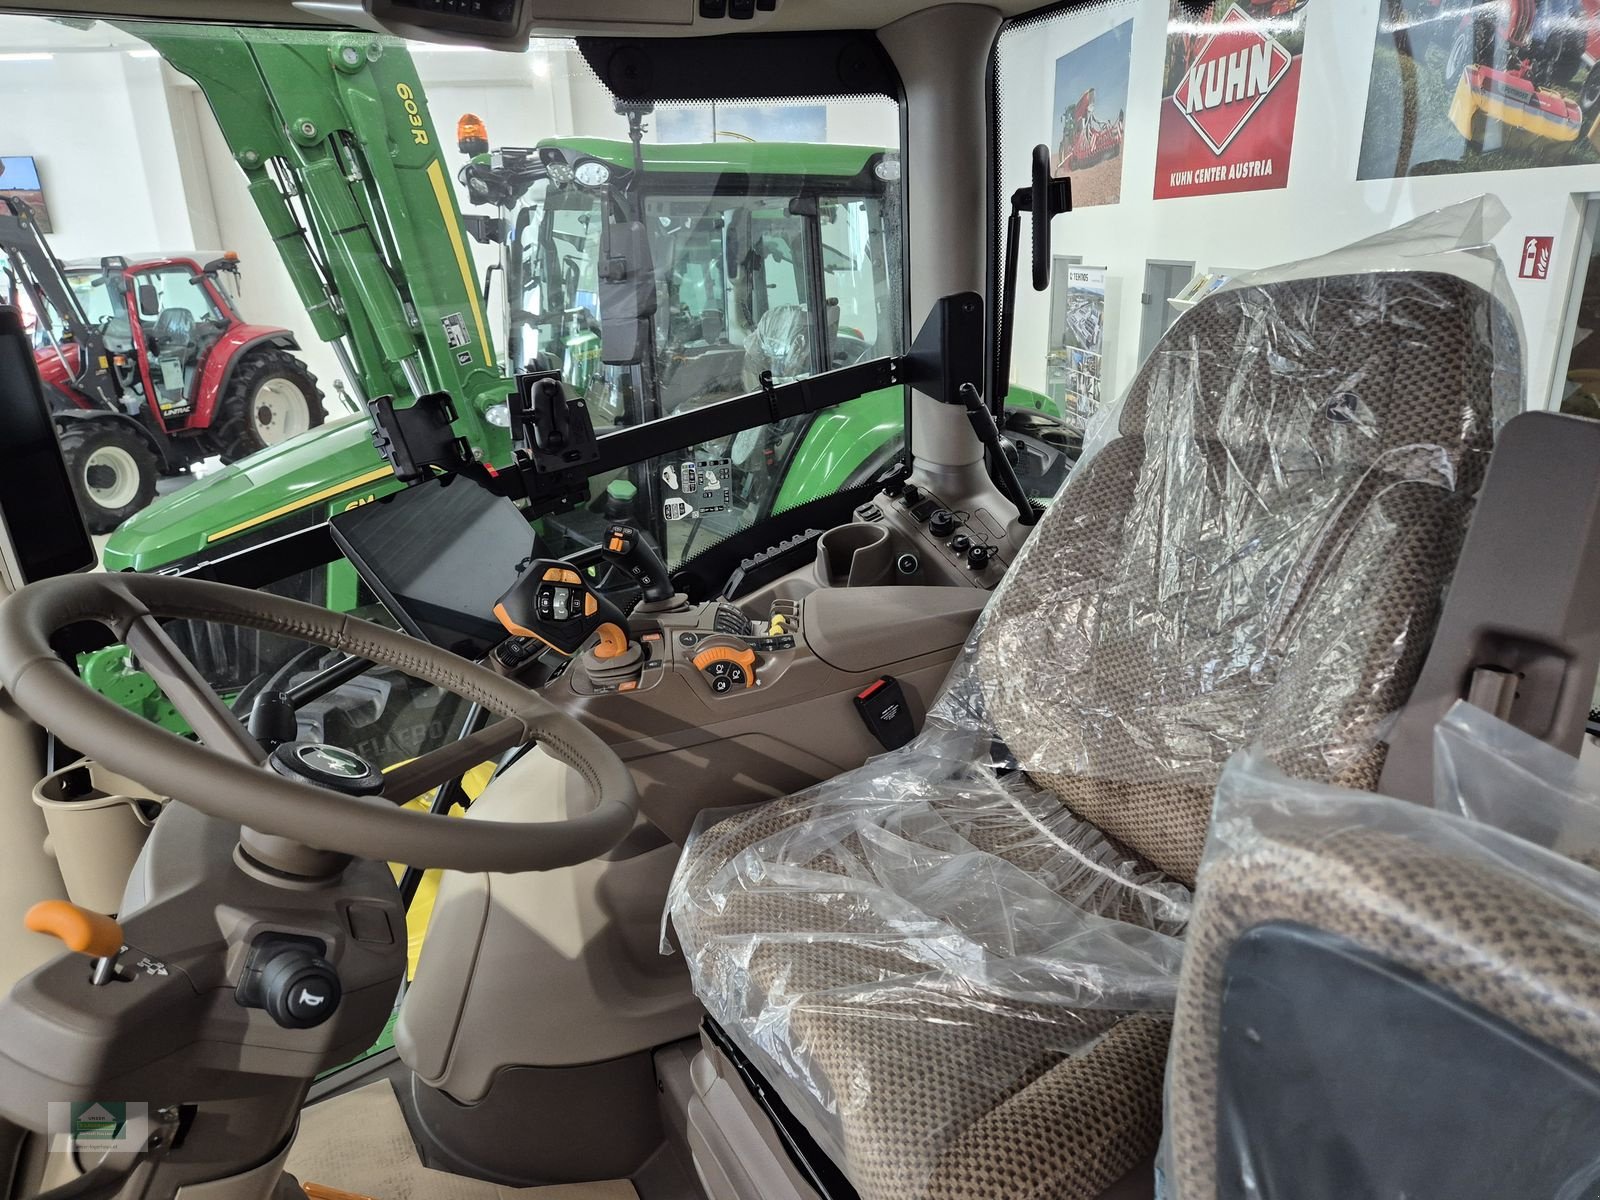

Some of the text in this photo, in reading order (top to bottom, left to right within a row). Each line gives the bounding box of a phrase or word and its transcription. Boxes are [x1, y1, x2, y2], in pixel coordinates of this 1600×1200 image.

[1186, 39, 1273, 114] KUHN
[396, 82, 430, 145] 603R
[1170, 159, 1273, 187] KUHN CENTER AUSTRIA
